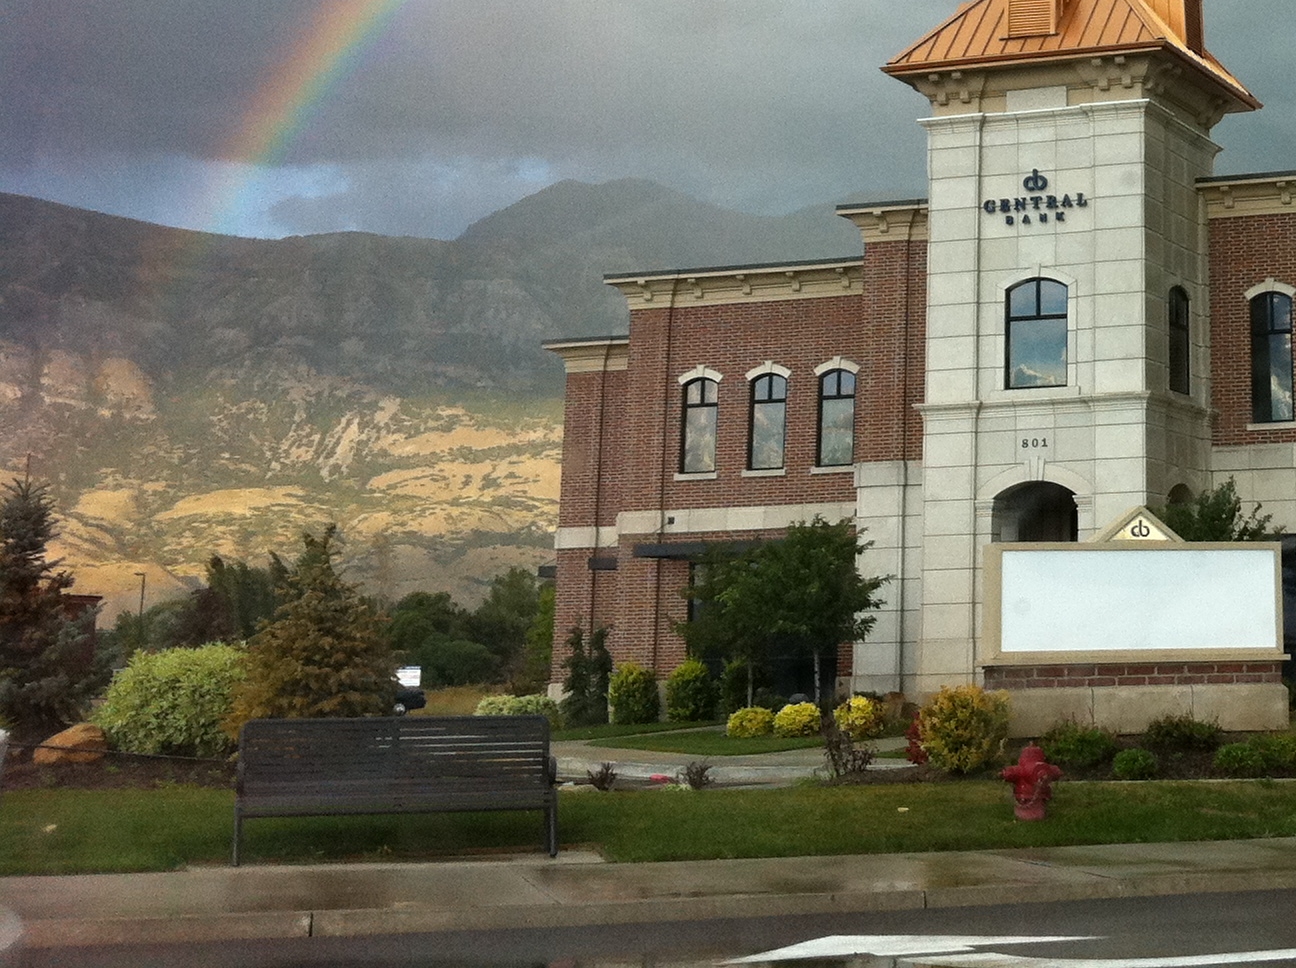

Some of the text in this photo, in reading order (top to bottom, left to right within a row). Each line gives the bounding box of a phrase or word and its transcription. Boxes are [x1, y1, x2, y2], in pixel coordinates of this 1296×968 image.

[983, 193, 1088, 213] CENTRAL
[1005, 212, 1065, 225] BANK
[1021, 437, 1048, 448] 801
